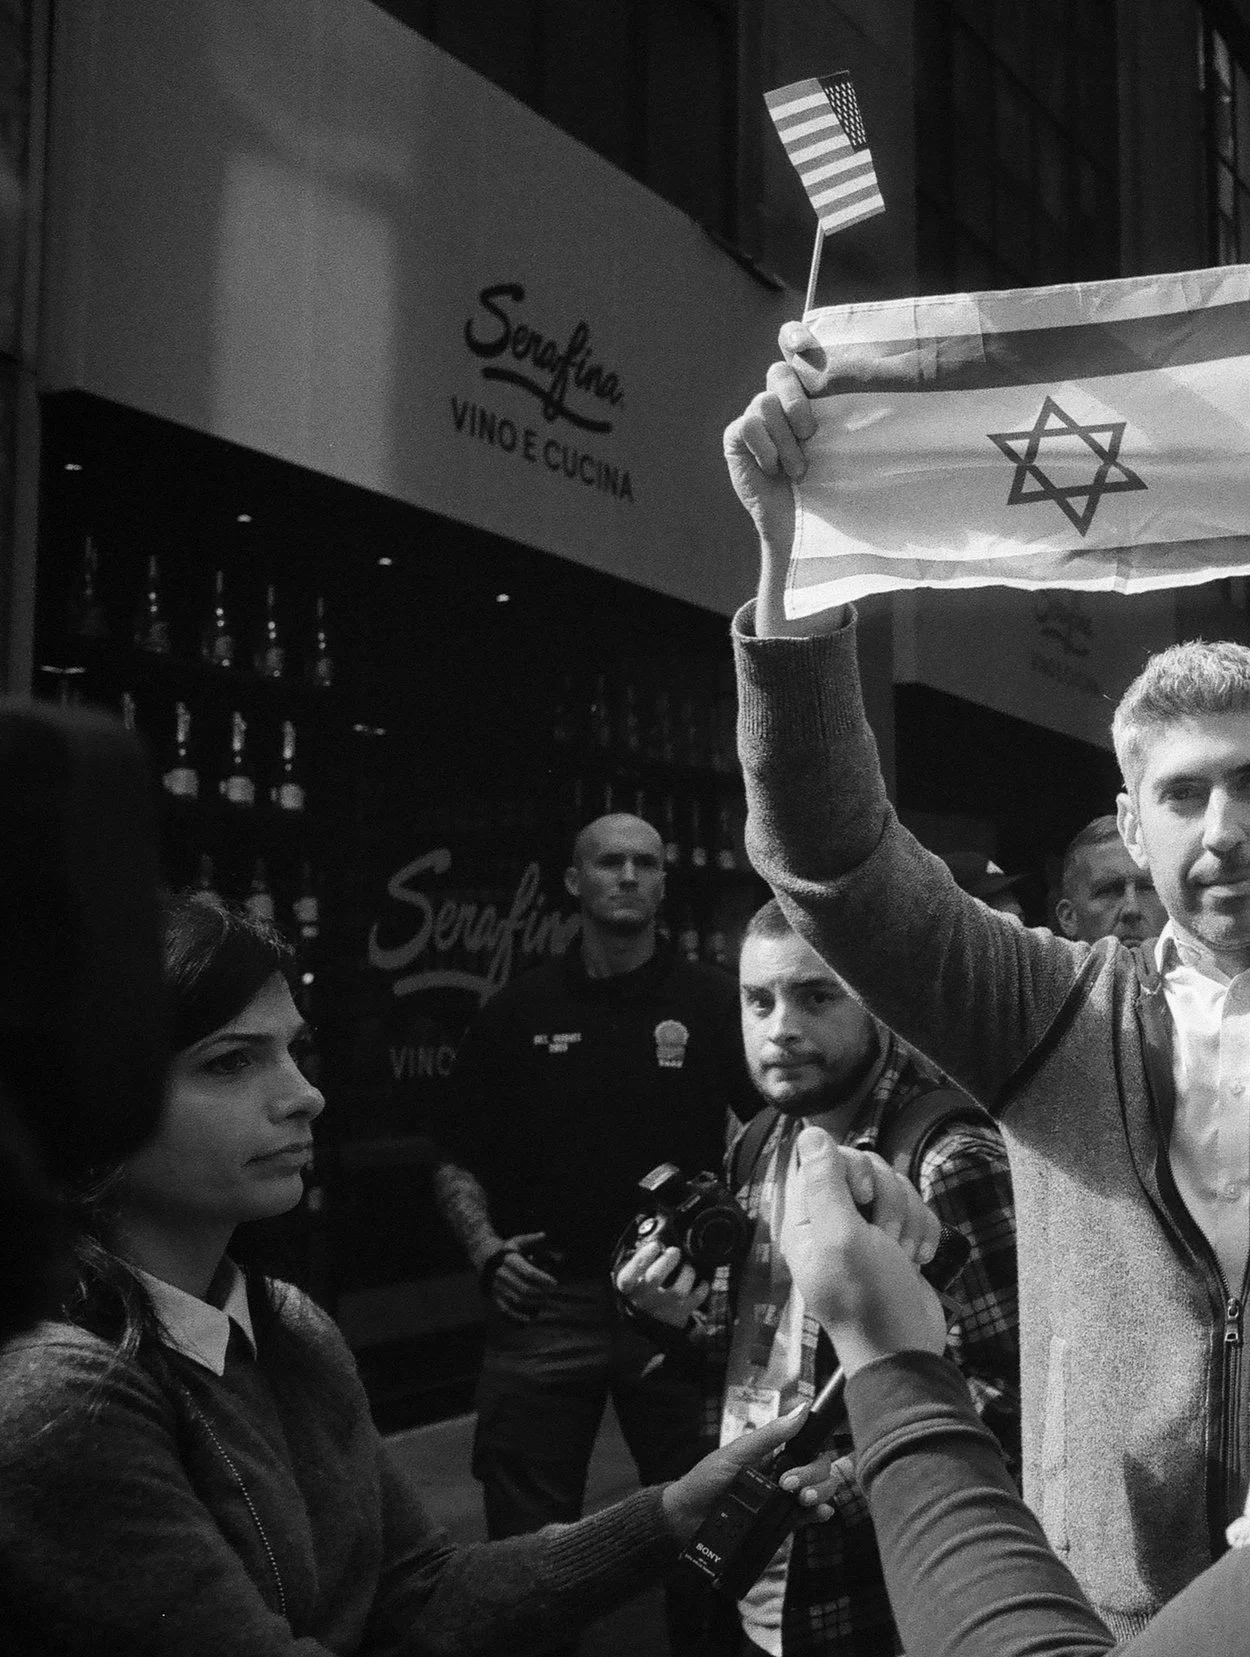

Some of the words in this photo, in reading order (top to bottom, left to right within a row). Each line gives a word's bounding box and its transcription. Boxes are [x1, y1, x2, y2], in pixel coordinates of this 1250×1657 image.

[463, 282, 625, 423] Serafina
[451, 395, 518, 453] VINO
[523, 428, 538, 463] E
[543, 438, 636, 503] CUCINA
[368, 848, 582, 1009] Serafin
[389, 1045, 457, 1079] VINO
[695, 1542, 722, 1563] SONY
